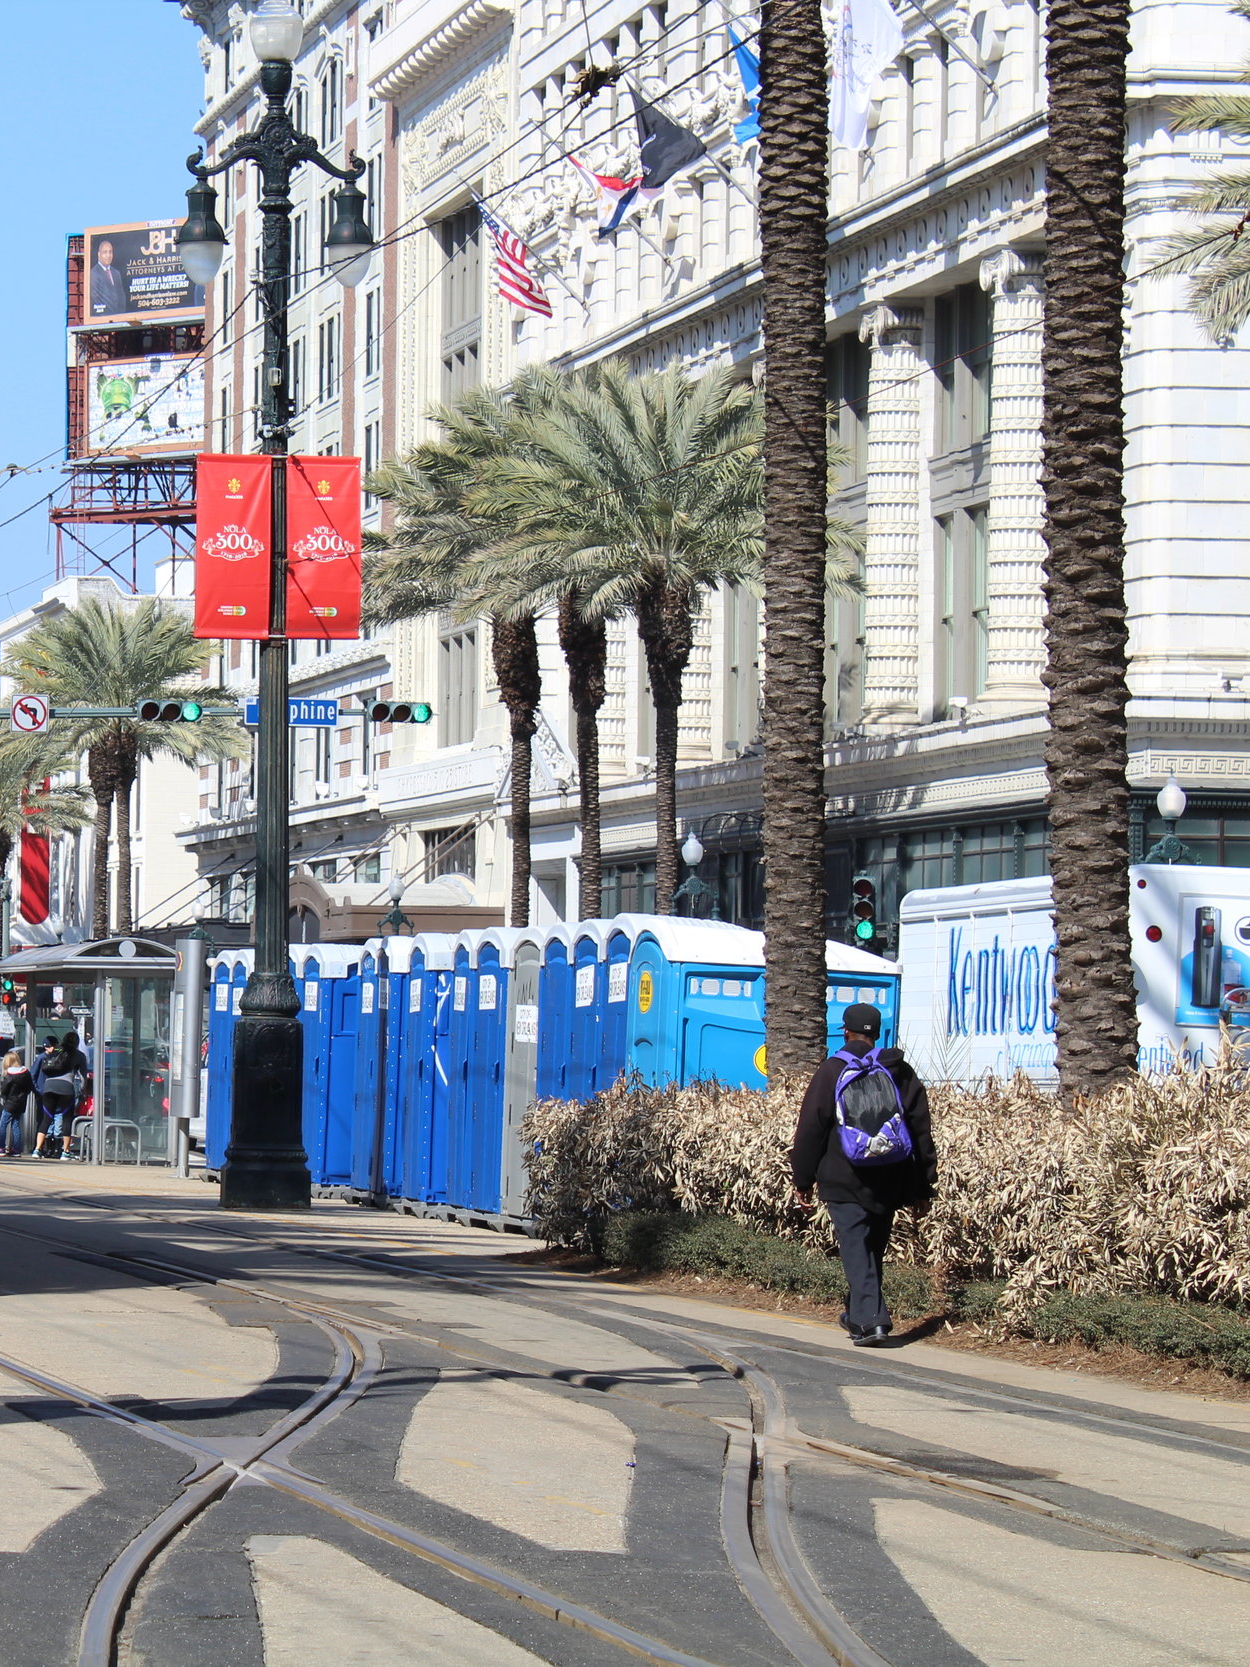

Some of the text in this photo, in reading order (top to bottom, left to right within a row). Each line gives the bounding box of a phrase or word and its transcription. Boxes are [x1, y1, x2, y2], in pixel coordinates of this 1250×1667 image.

[156, 255, 182, 264] HARRIS
[126, 265, 165, 276] ATTORNEYS
[131, 274, 187, 286] HURT IN A WRECK?
[129, 280, 190, 293] YOUR LIFE MATTERS!
[137, 297, 180, 308] 504-603-3222
[223, 524, 247, 533] NOLA
[313, 525, 337, 535] NOLA
[215, 532, 252, 550] 300
[306, 533, 343, 551] 300
[290, 701, 335, 723] phine
